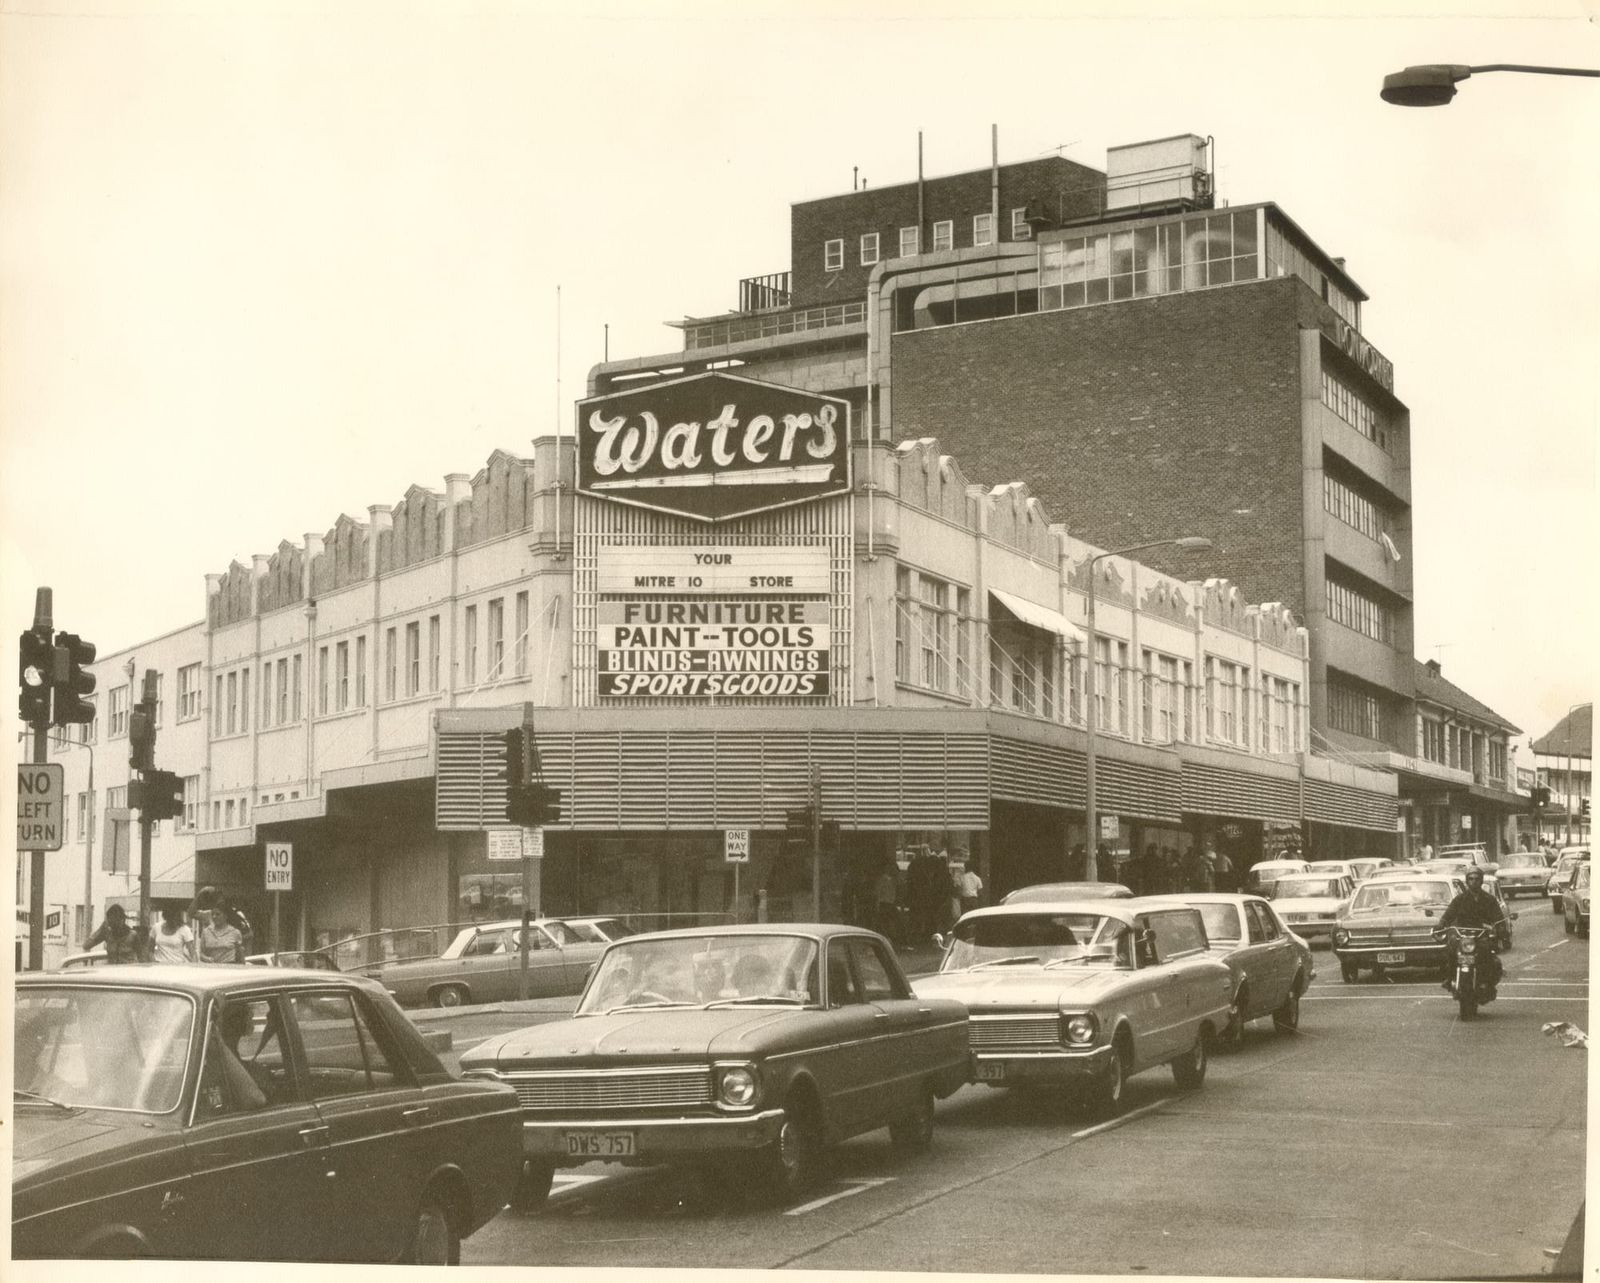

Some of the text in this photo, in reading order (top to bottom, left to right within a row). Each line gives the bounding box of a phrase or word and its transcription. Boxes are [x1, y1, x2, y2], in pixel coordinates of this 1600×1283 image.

[589, 404, 837, 475] Waters
[694, 553, 732, 565] YOUR
[634, 576, 675, 587] MITRE
[750, 576, 793, 587] STORE
[624, 603, 805, 624] FURNITURE
[18, 771, 51, 795] NO
[17, 824, 56, 841] URN
[728, 832, 746, 840] ONE
[728, 842, 746, 850] WAY
[270, 850, 288, 866] NO
[268, 870, 290, 883] ENTRY
[568, 1135, 632, 1154] DWS 757
